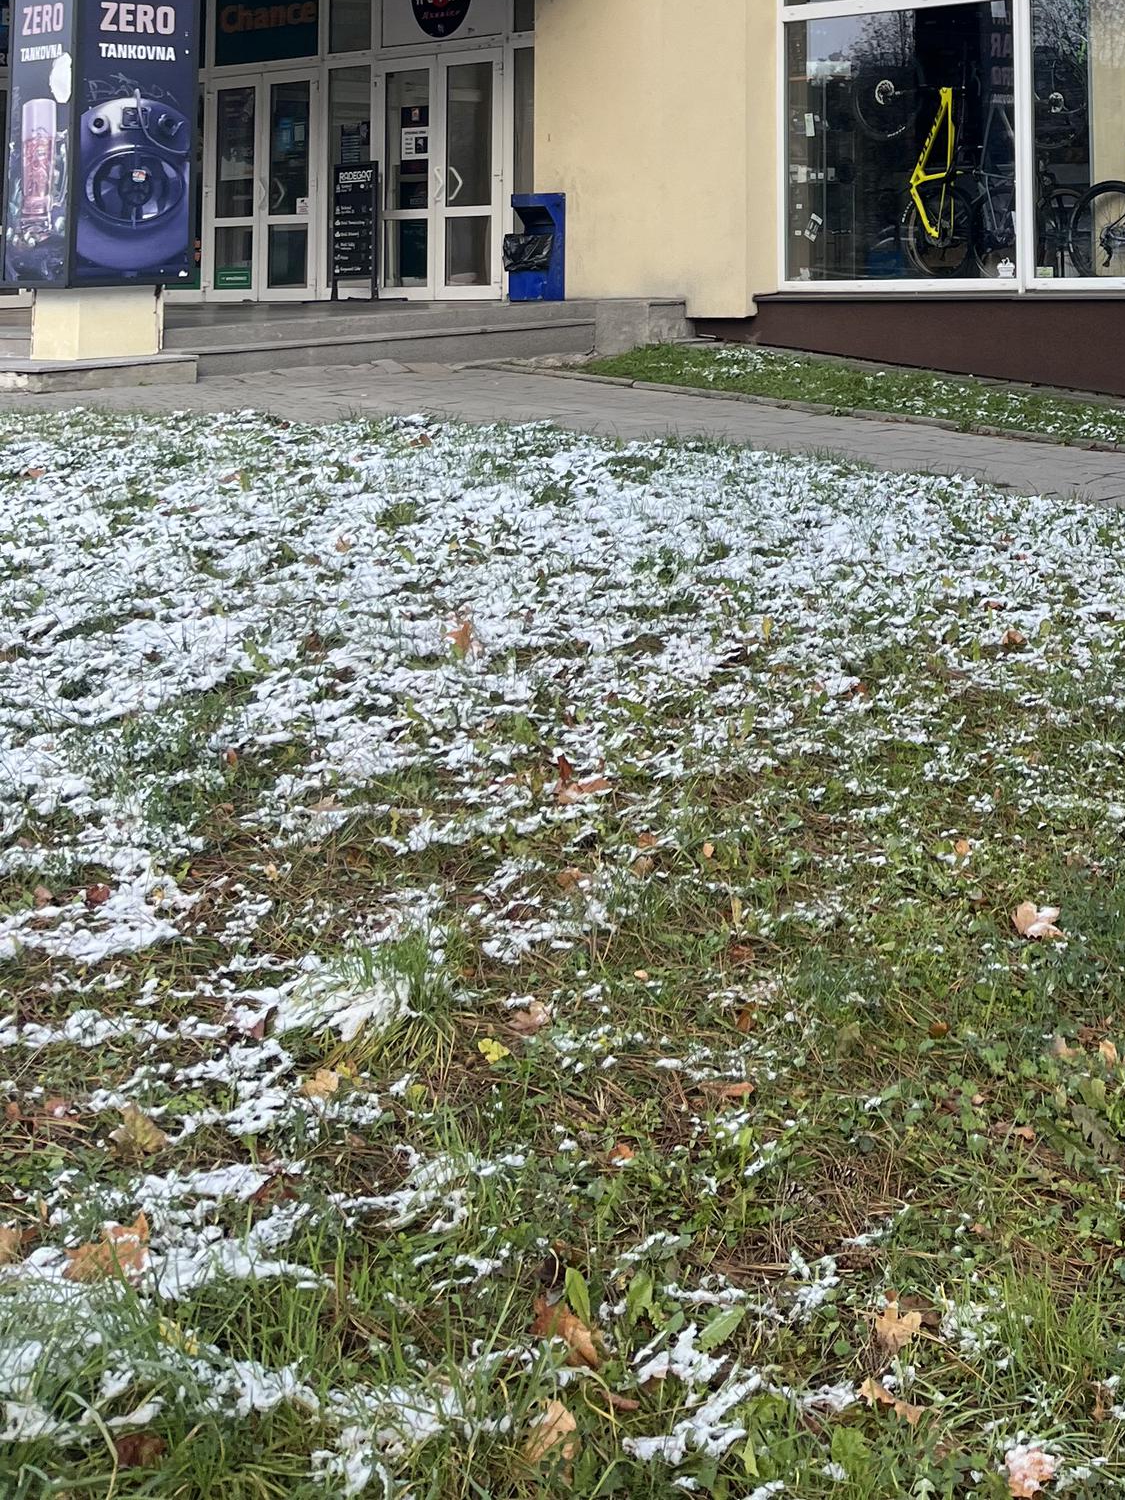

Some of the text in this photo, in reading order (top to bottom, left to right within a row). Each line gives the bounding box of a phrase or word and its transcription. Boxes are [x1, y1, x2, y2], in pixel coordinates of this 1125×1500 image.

[22, 2, 64, 36] ZERO
[100, 1, 175, 35] ZERO
[221, 2, 317, 34] Chance
[20, 44, 63, 62] TANKOVNA
[99, 42, 176, 62] TANKOVNA
